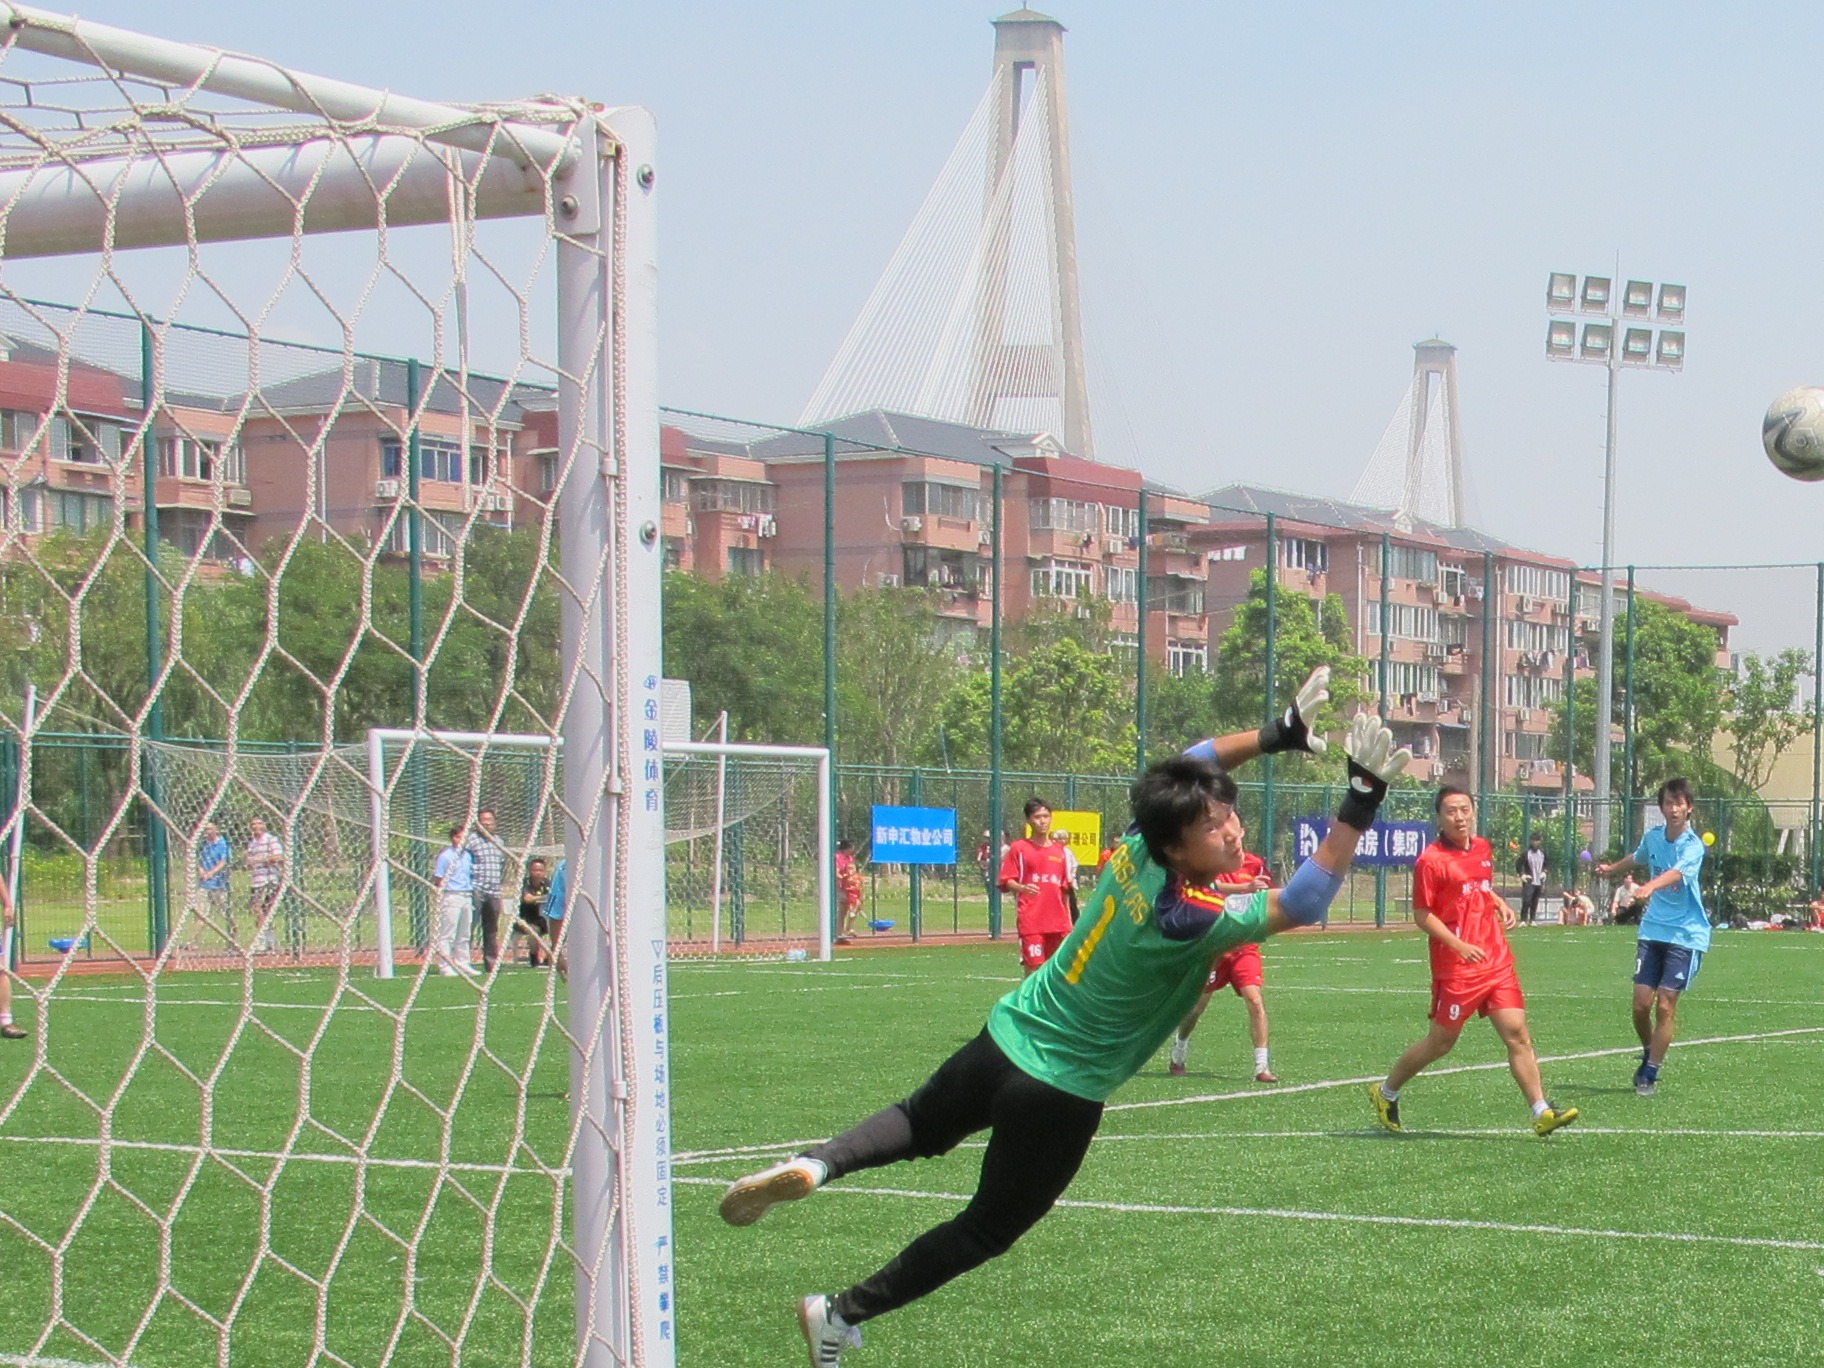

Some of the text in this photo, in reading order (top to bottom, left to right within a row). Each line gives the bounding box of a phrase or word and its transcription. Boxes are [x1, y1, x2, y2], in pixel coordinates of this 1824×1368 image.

[1065, 895, 1116, 985] 1
[1028, 944, 1042, 957] 16
[1449, 1004, 1460, 1020] 9
